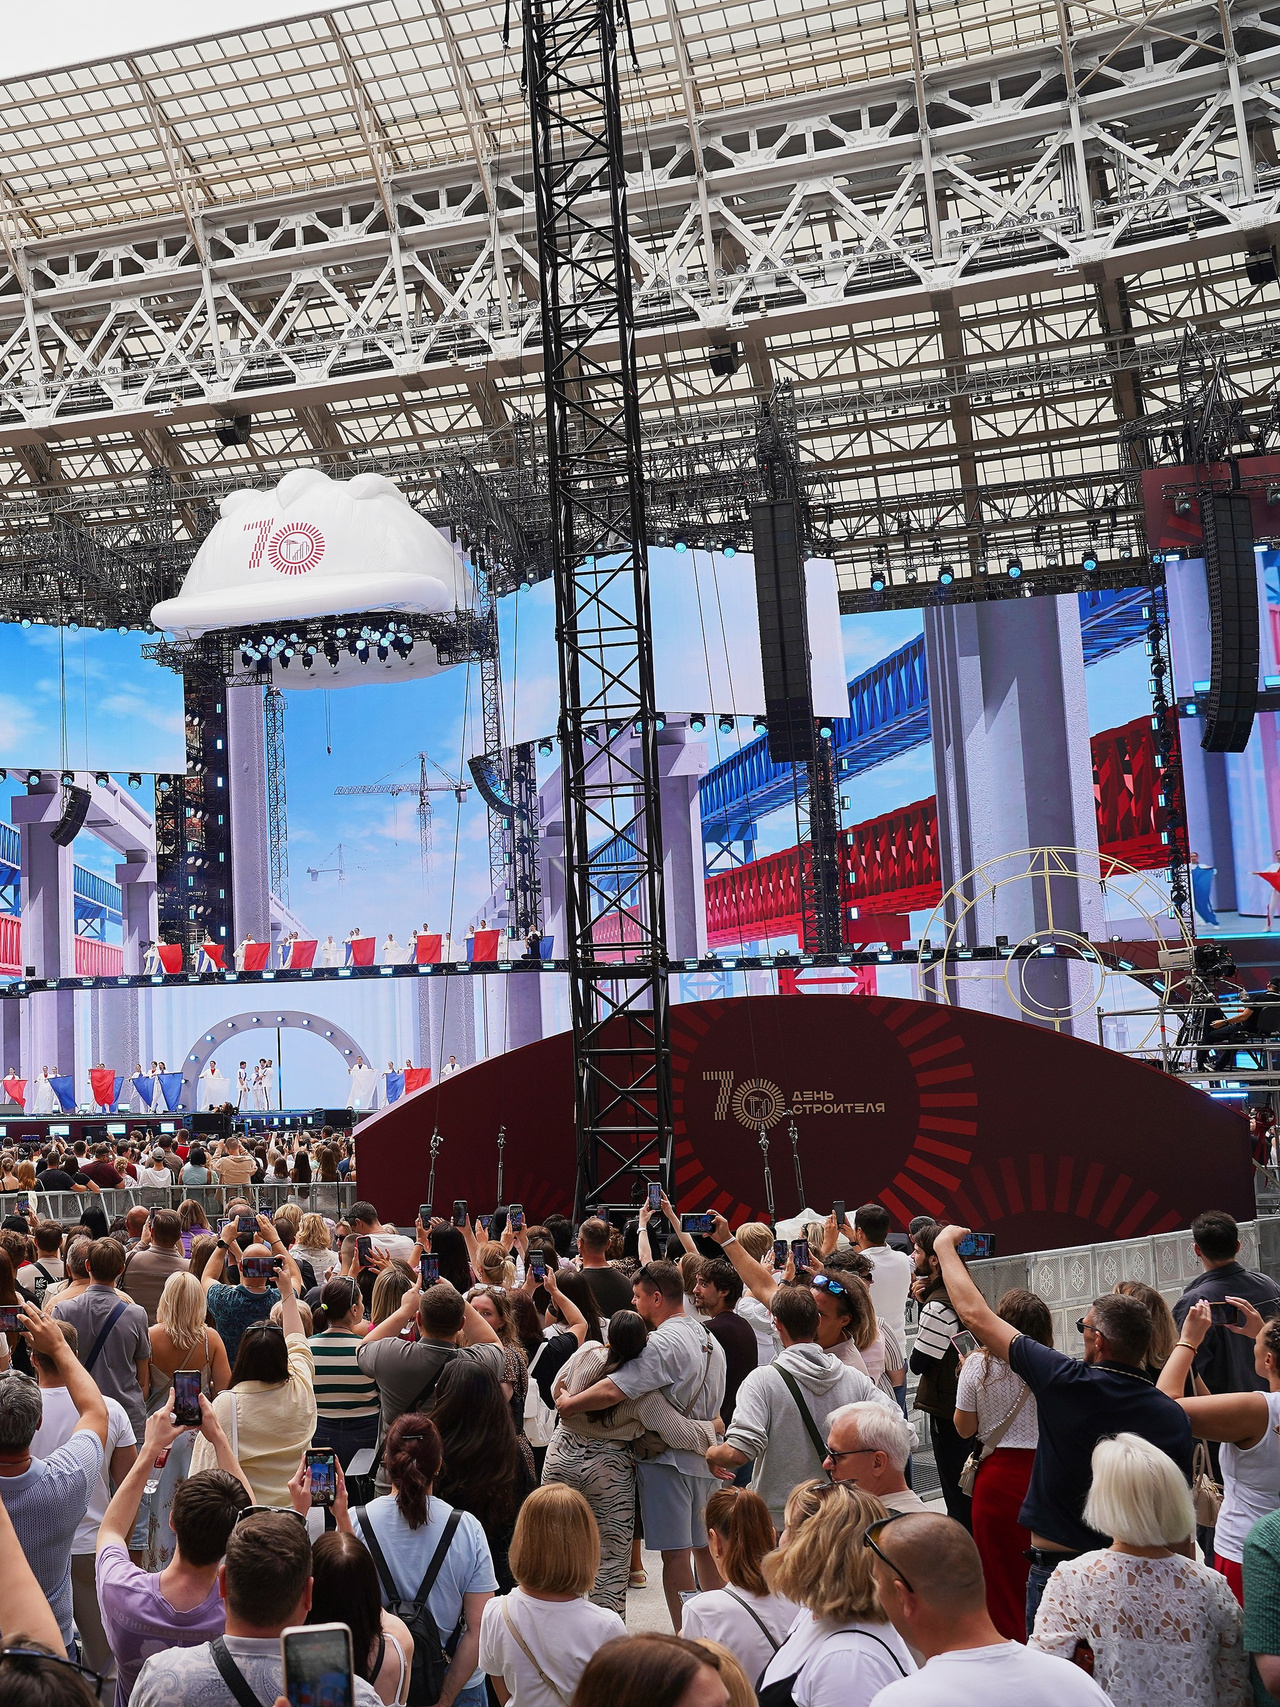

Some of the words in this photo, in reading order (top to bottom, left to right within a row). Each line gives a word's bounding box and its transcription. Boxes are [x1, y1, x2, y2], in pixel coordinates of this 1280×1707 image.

[792, 1090, 834, 1101] ДЕНЬ
[792, 1103, 885, 1114] СТРОИТЕЛЯ
[114, 1608, 159, 1633] NOTHING
